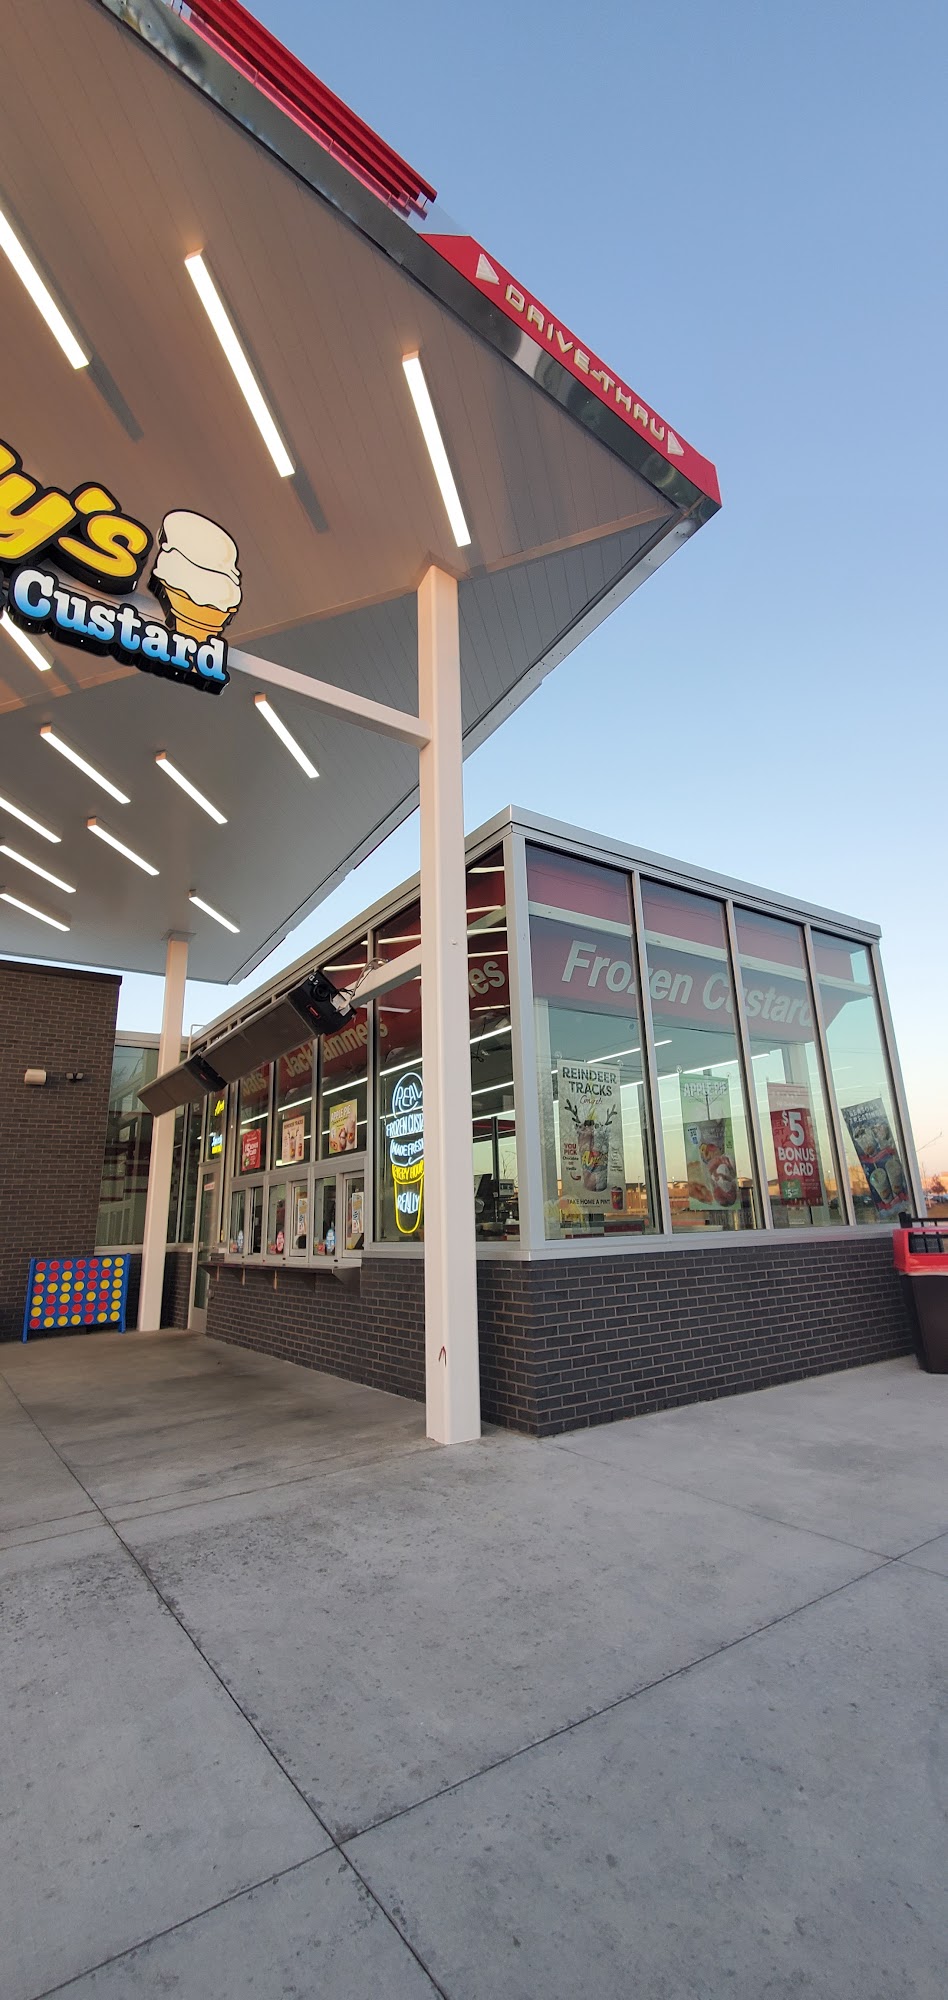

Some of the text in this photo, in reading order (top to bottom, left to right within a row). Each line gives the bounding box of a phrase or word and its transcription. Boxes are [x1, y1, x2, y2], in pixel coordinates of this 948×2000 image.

[505, 284, 665, 442] DRIVE-THRU
[0, 442, 149, 578] y's
[14, 569, 227, 681] Custard
[562, 940, 694, 1004] Froen
[562, 1066, 617, 1084] REINDEER
[395, 1082, 422, 1107] REAL
[568, 1081, 613, 1097] TRACKS
[386, 1115, 408, 1137] FROZEN
[392, 1141, 408, 1156] MADE
[778, 1147, 815, 1162] BONUS
[784, 1162, 814, 1176] CARD
[396, 1191, 420, 1214] REALLY
